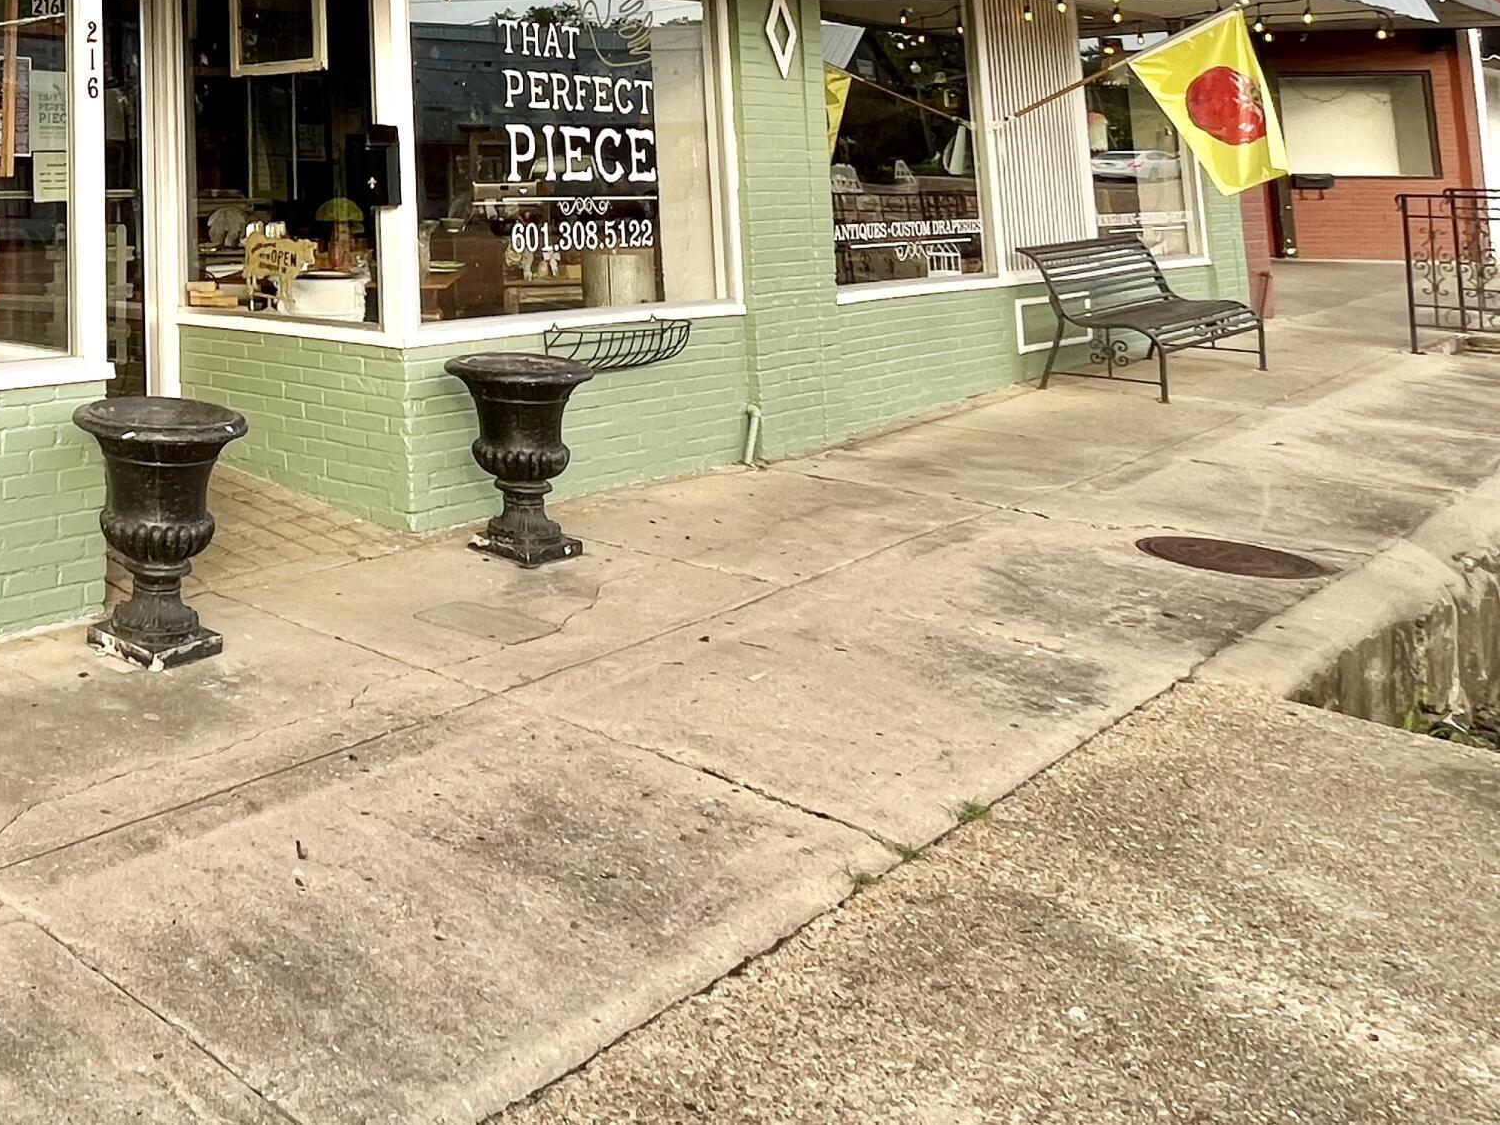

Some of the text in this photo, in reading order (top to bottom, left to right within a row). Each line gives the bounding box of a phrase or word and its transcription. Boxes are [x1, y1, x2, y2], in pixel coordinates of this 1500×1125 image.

[86, 20, 100, 99] 216
[498, 18, 580, 60] THAT
[501, 69, 653, 116] PERFECT
[39, 113, 67, 124] PIEC
[505, 124, 657, 183] PIECE
[511, 219, 654, 253] 601.308.5122
[271, 249, 297, 267] OPEN
